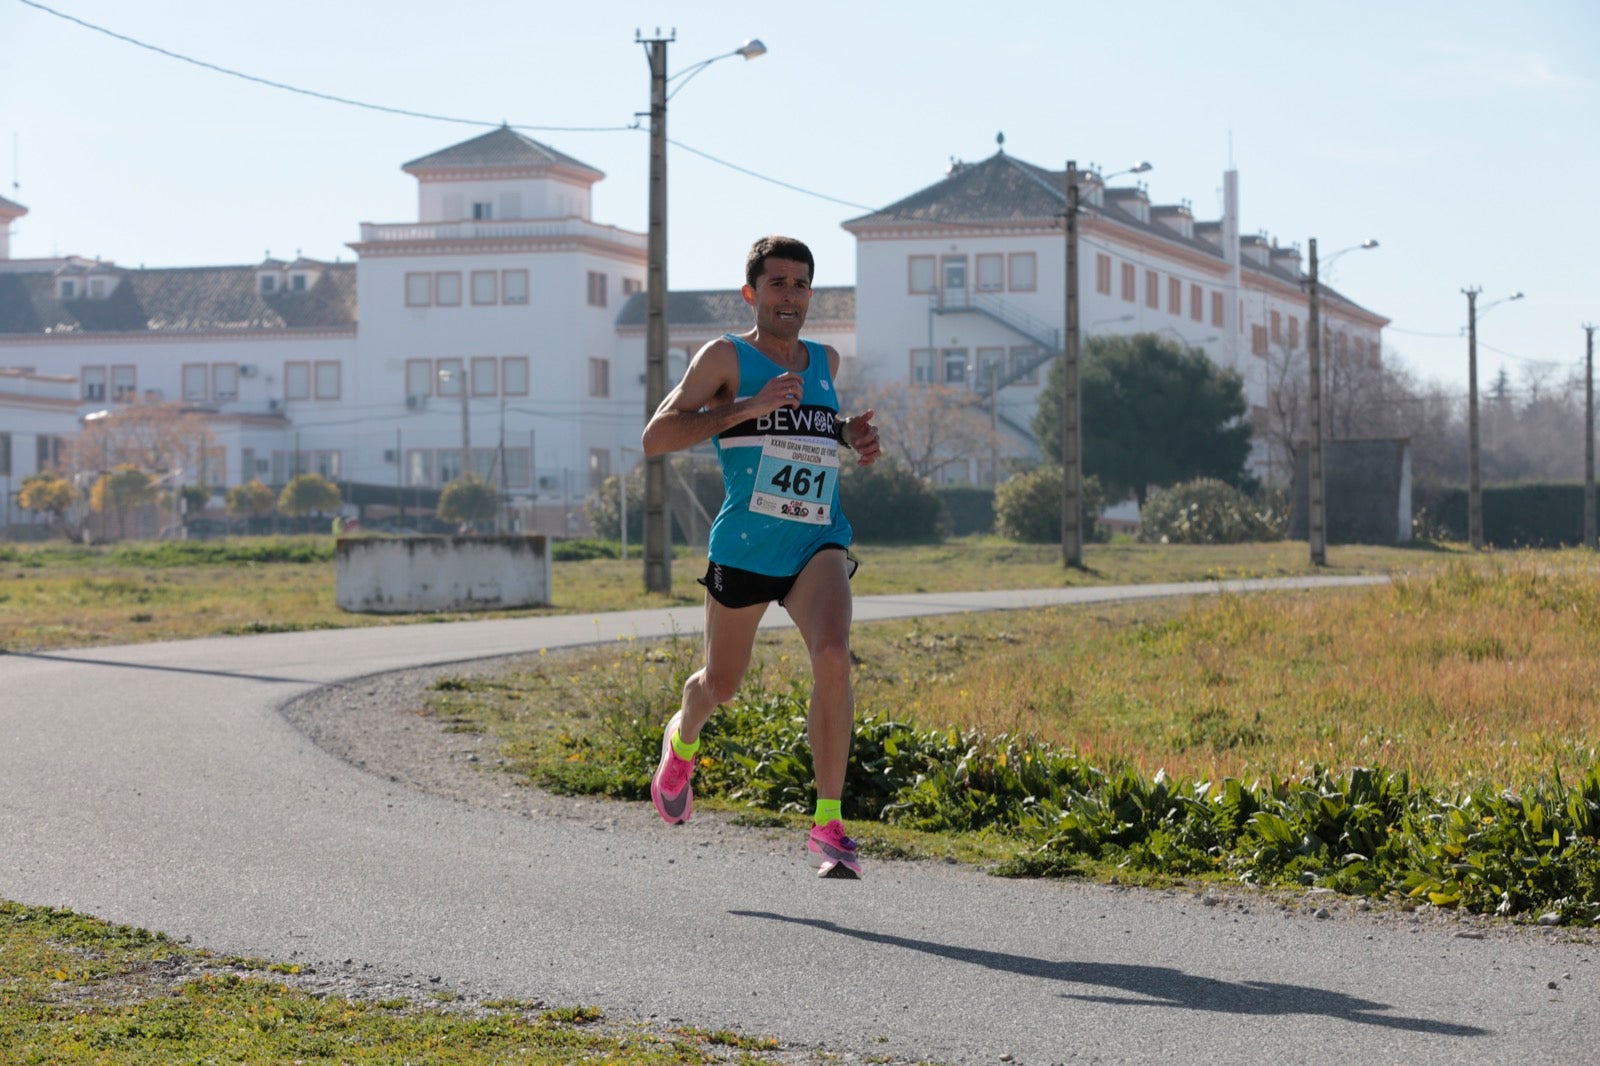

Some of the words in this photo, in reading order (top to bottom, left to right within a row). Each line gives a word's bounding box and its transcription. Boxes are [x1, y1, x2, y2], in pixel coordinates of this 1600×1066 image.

[787, 441, 801, 452] GRAN
[802, 444, 820, 454] PREMIO
[821, 447, 827, 456] DE
[771, 465, 826, 499] 461
